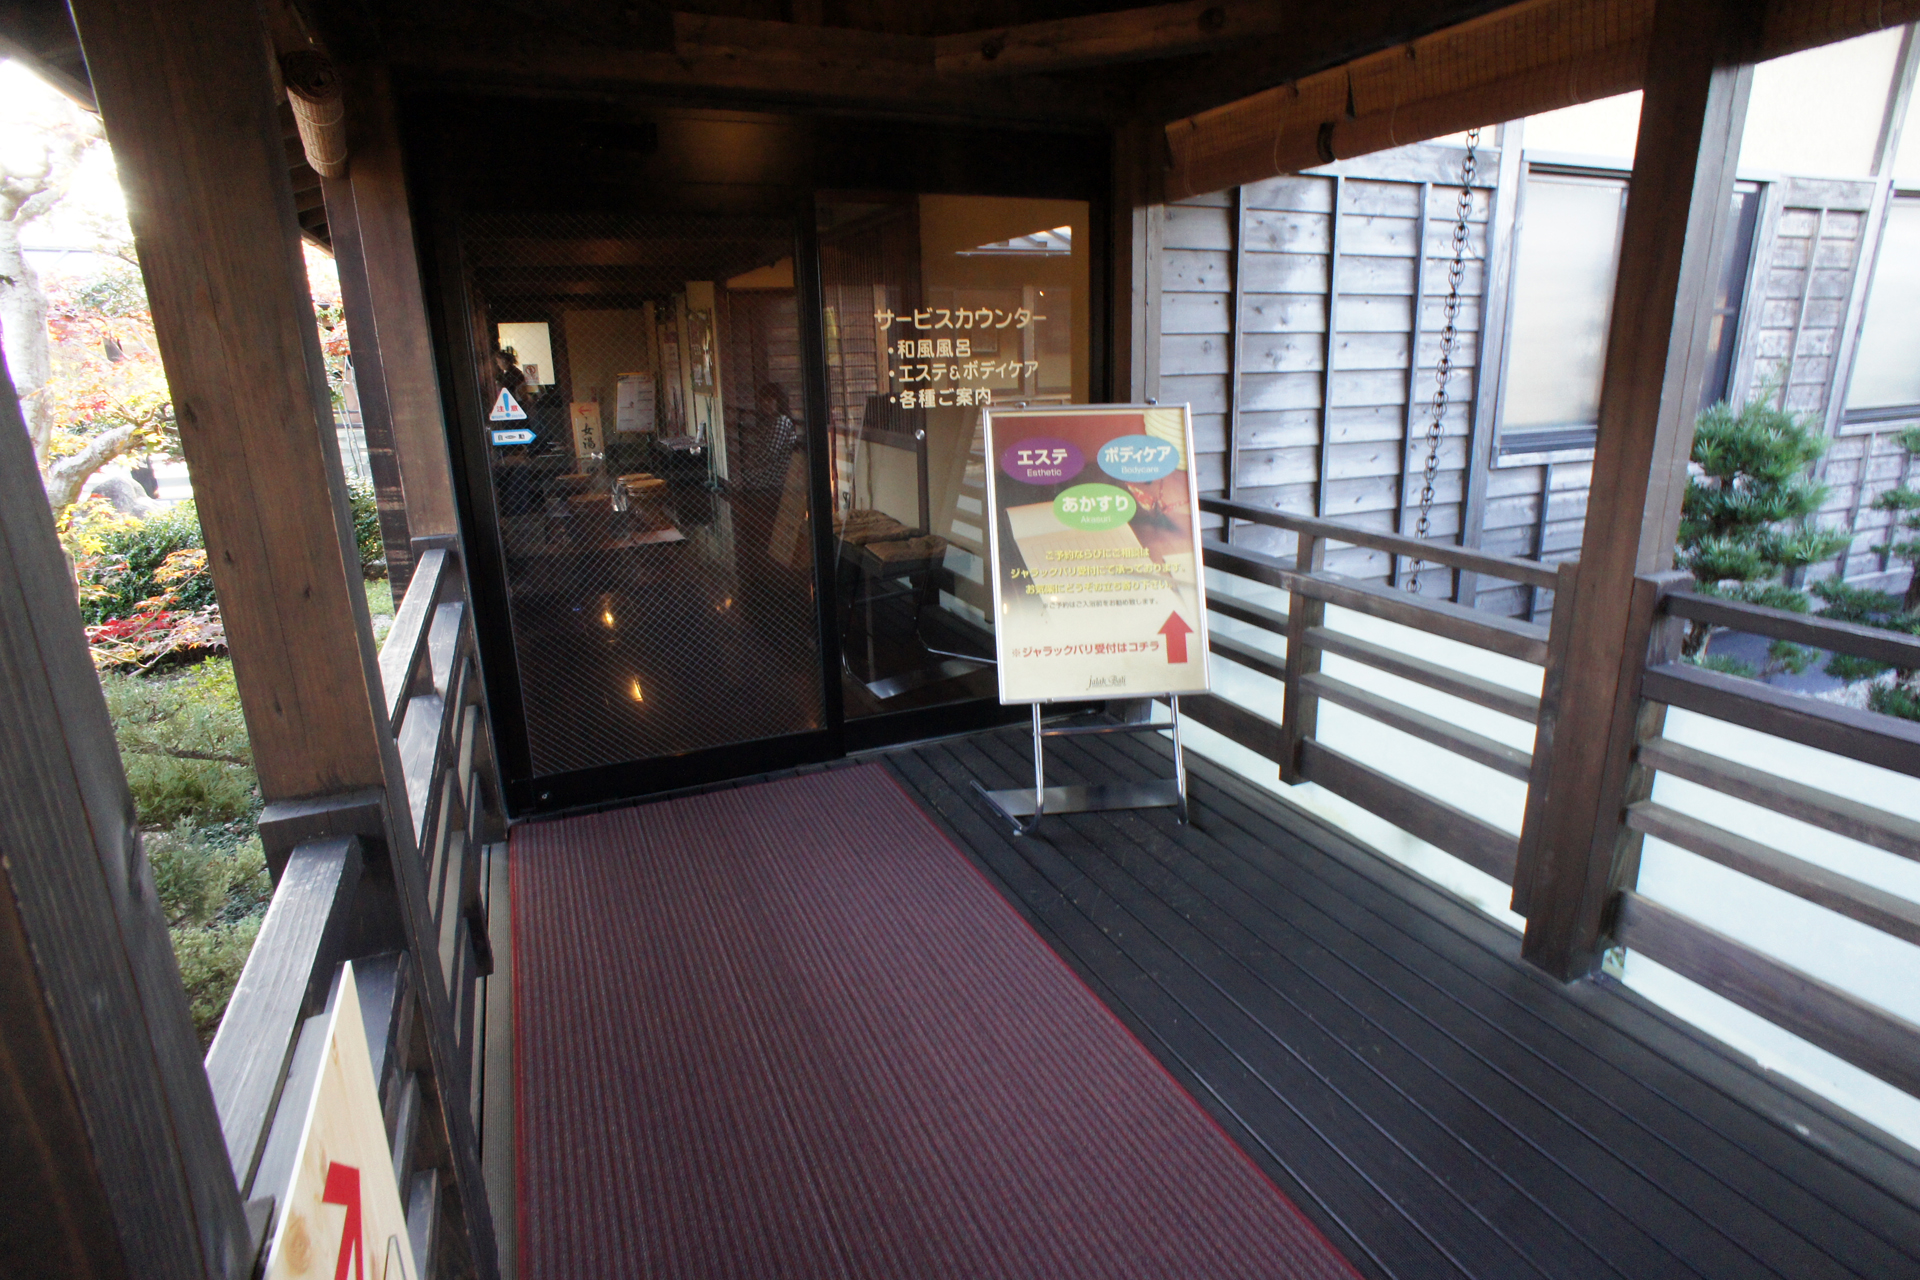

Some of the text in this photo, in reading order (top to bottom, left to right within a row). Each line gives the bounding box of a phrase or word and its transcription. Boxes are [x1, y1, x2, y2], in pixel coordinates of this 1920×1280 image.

[873, 306, 1047, 331] サービスカウンター
[1016, 448, 1069, 466] エステ
[1103, 445, 1172, 464] ボディケア
[1026, 468, 1063, 478] Esthetic
[1121, 465, 1160, 475] Bodycare
[1061, 494, 1130, 514] あかすり
[1080, 515, 1112, 525] Akasuri
